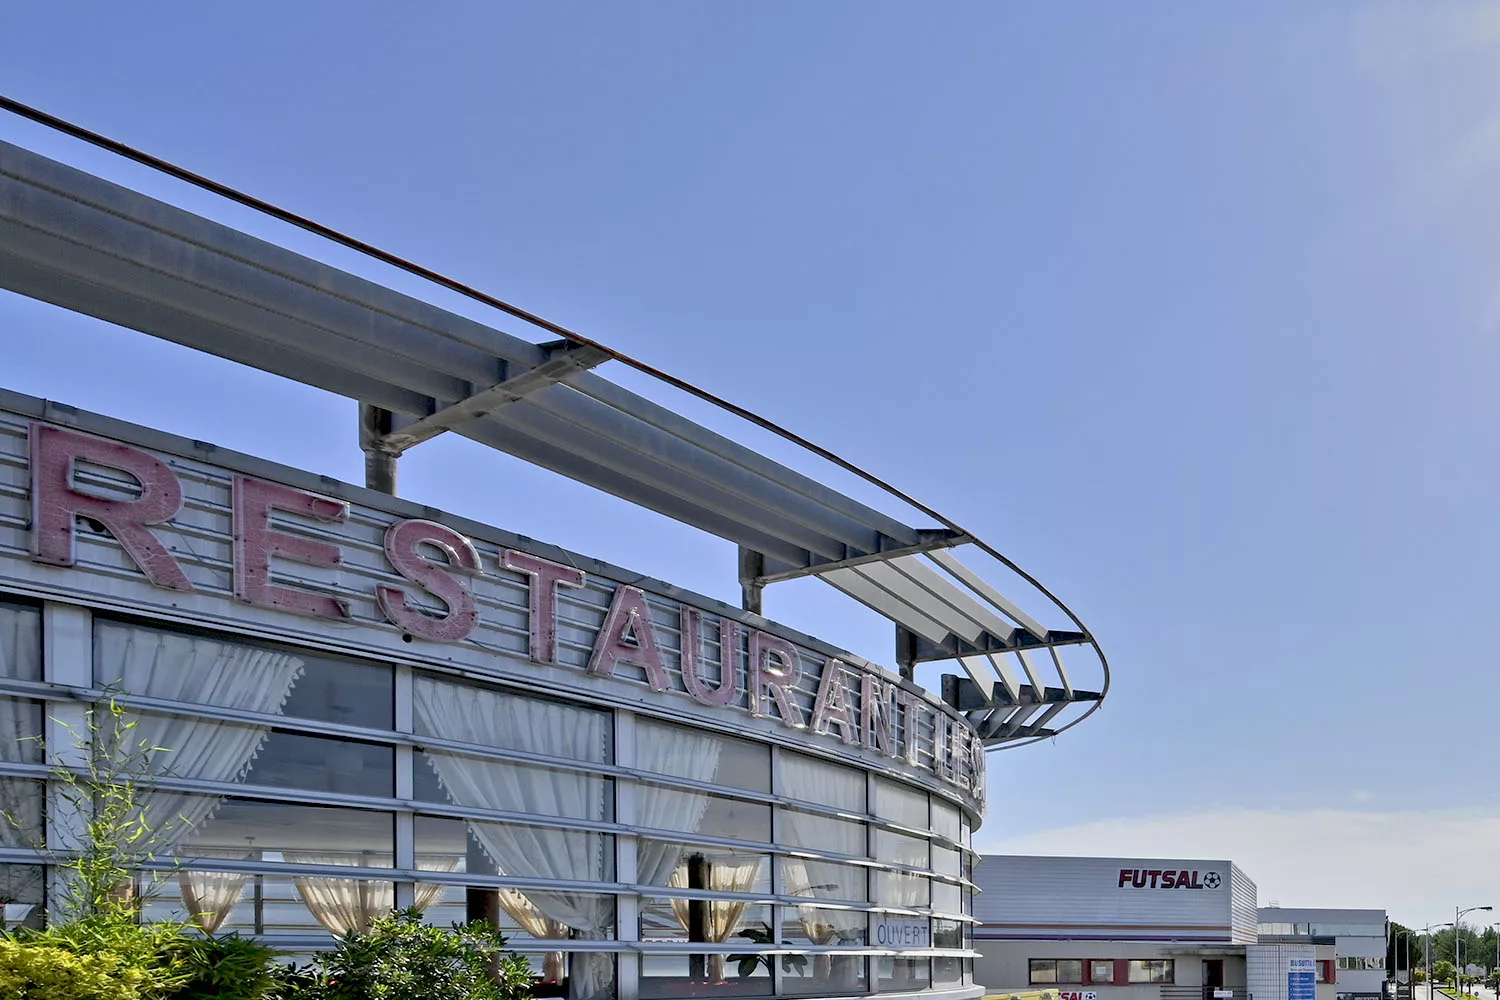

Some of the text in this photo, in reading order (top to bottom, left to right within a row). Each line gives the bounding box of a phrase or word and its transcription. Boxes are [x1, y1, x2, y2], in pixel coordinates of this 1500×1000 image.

[28, 422, 927, 768] RESTAURANT
[1118, 869, 1203, 889] FUTSAL
[877, 923, 928, 945] OUVERT
